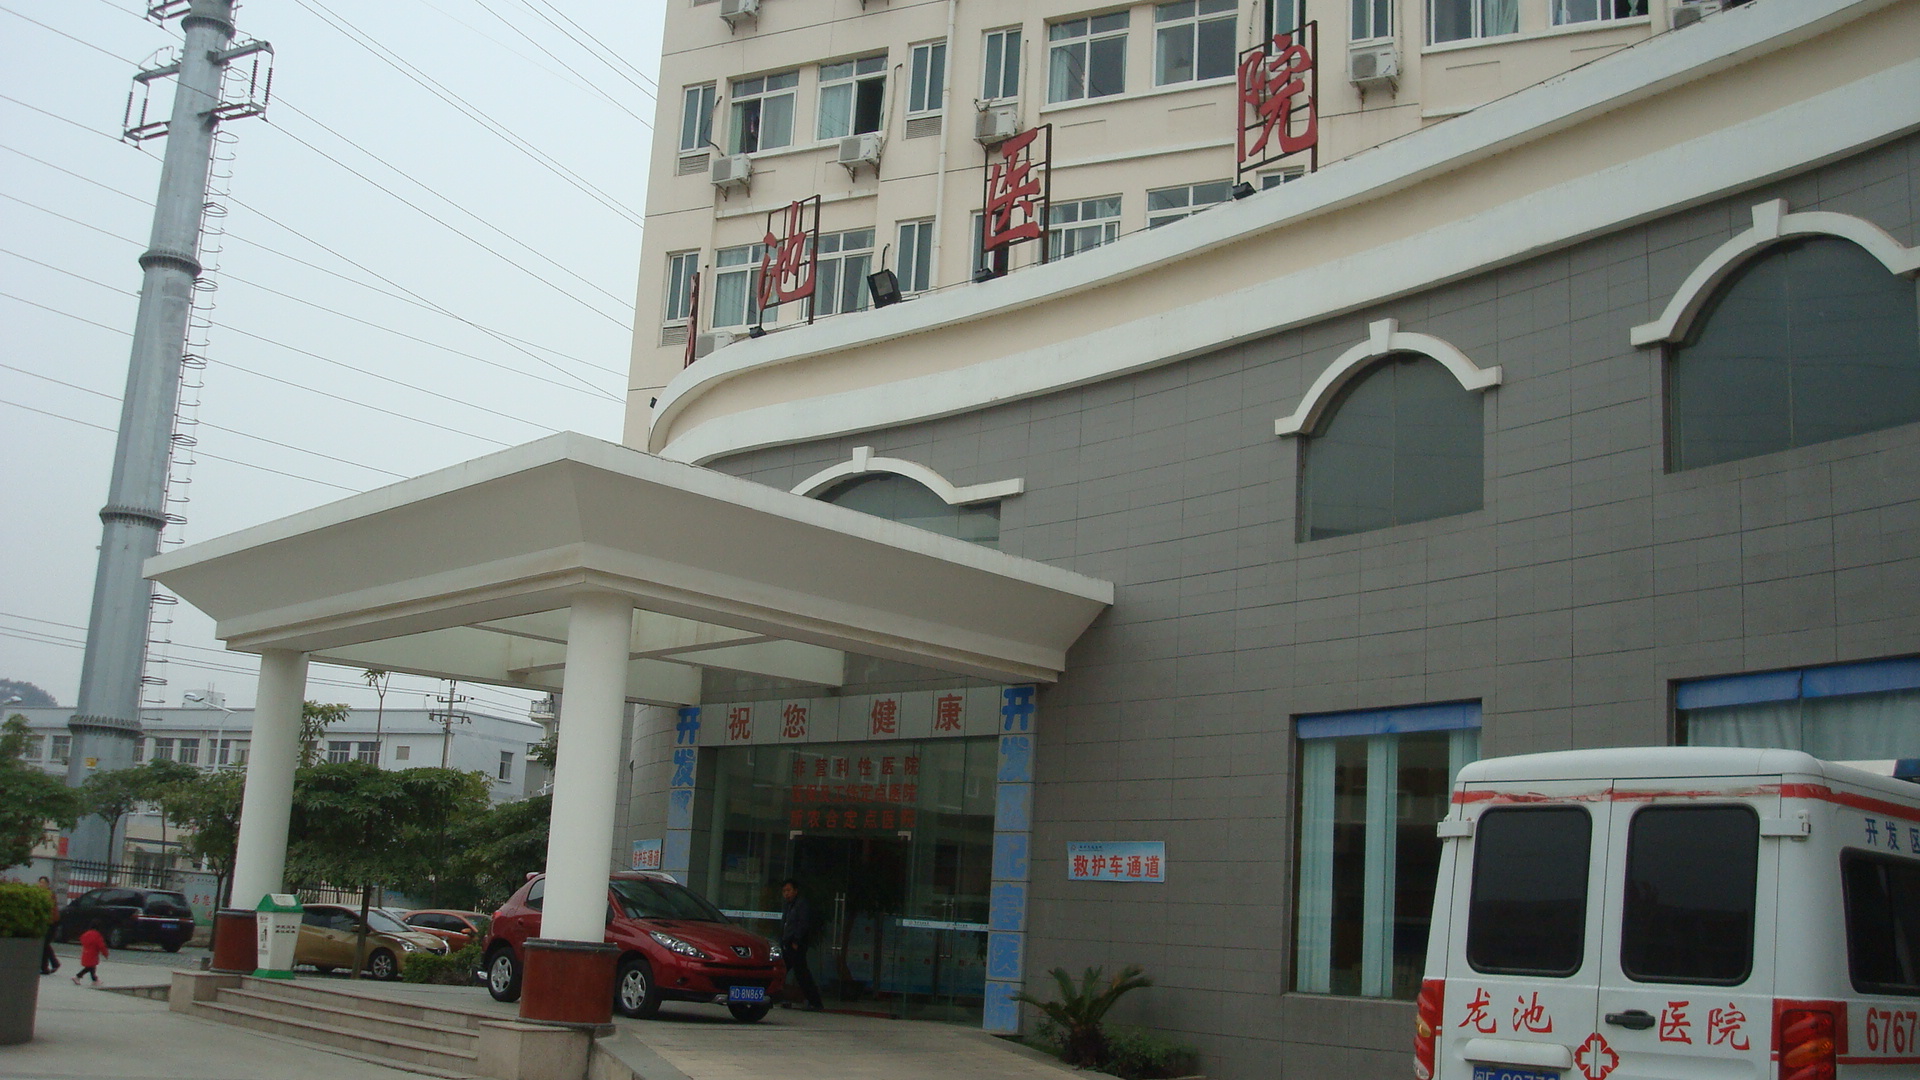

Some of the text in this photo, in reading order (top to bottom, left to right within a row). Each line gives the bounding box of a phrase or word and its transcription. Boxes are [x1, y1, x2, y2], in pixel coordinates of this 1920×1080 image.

[728, 694, 963, 740] 祝您健康
[793, 756, 919, 777] 非营利性医院
[1865, 818, 1920, 854] 开发区
[1073, 854, 1160, 878] 救护车通道
[1866, 1007, 1920, 1054] 6767
